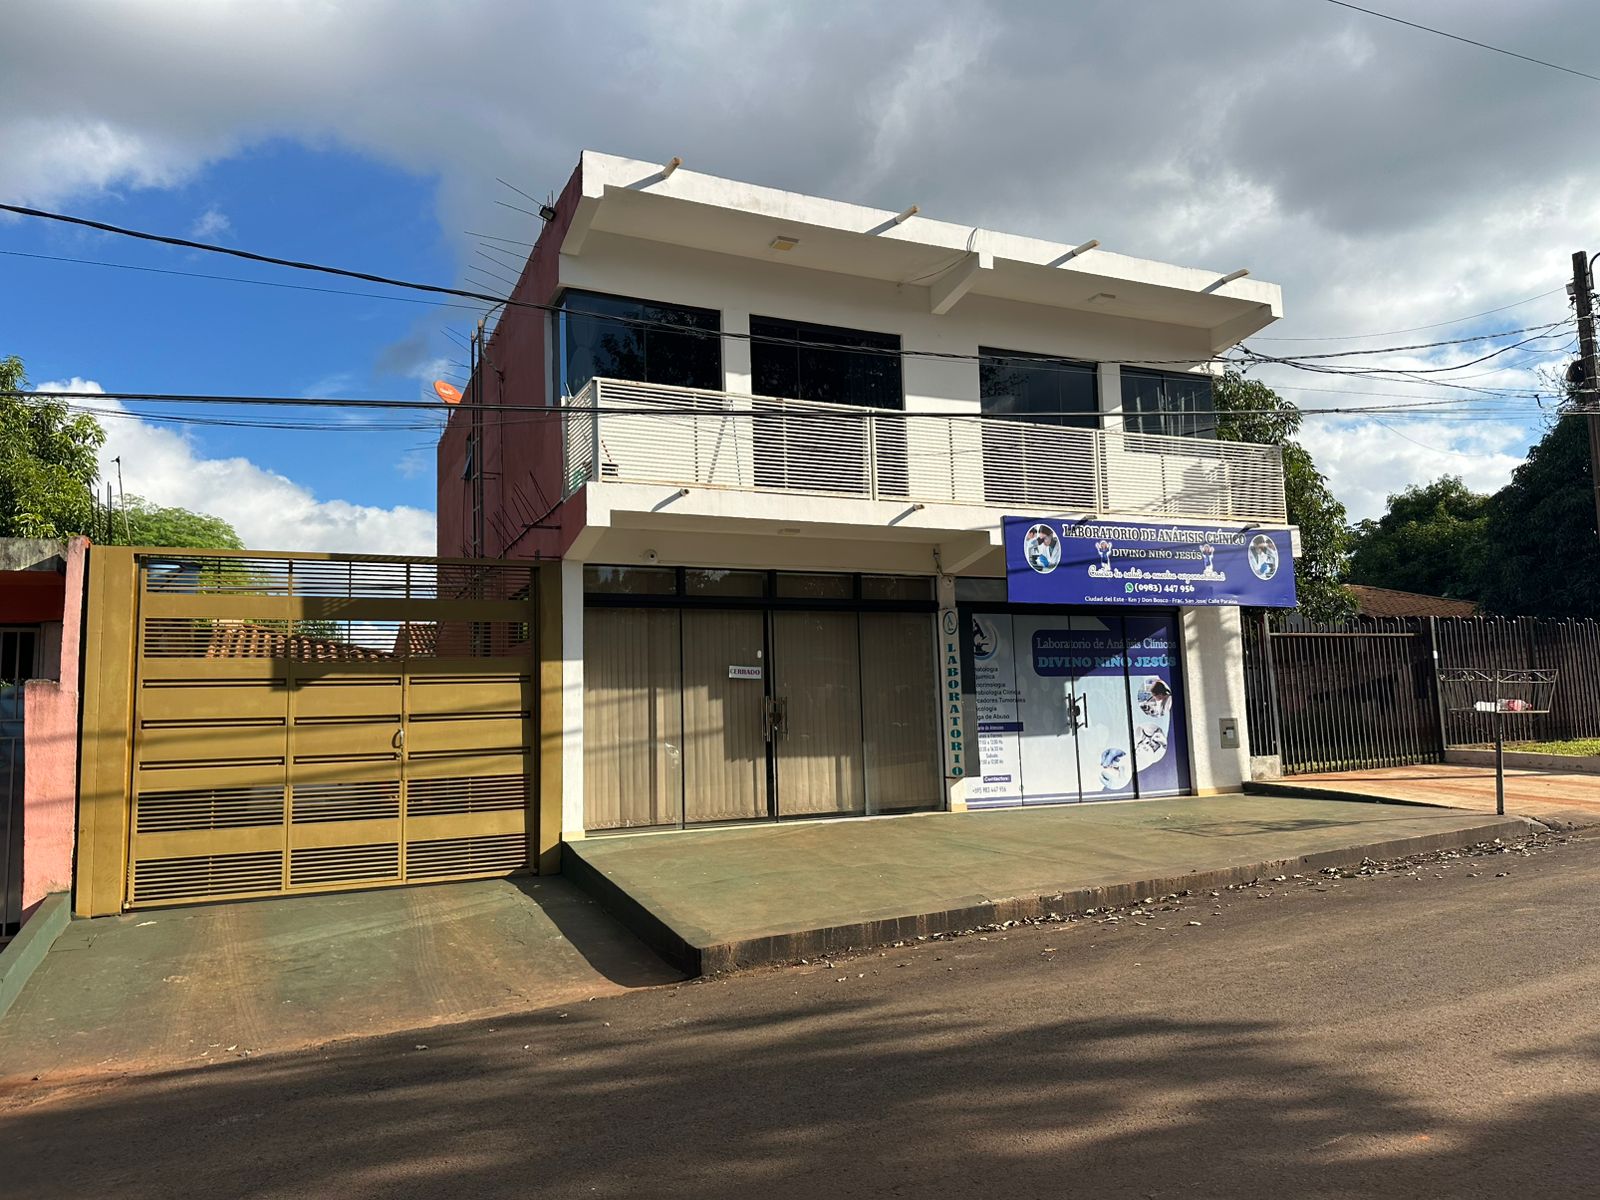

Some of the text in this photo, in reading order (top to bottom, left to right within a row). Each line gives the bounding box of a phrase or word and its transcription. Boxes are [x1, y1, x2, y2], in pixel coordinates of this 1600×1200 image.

[1062, 524, 1247, 545] LABORATORIO DE ANÁLISIS CLÍNICO
[1112, 548, 1203, 560] DIVINO NIÑO JESÚS
[1134, 583, 1195, 593] (0983) 447 956
[1084, 595, 1103, 603] Ciudad
[1036, 637, 1091, 649] Laboratorio
[1093, 637, 1105, 649] de
[1143, 637, 1177, 650] Clínicos
[1037, 652, 1177, 668] DIVINO NIÑO JESÚS
[730, 668, 761, 676] CERRADO
[947, 643, 963, 776] LABORATORIO
